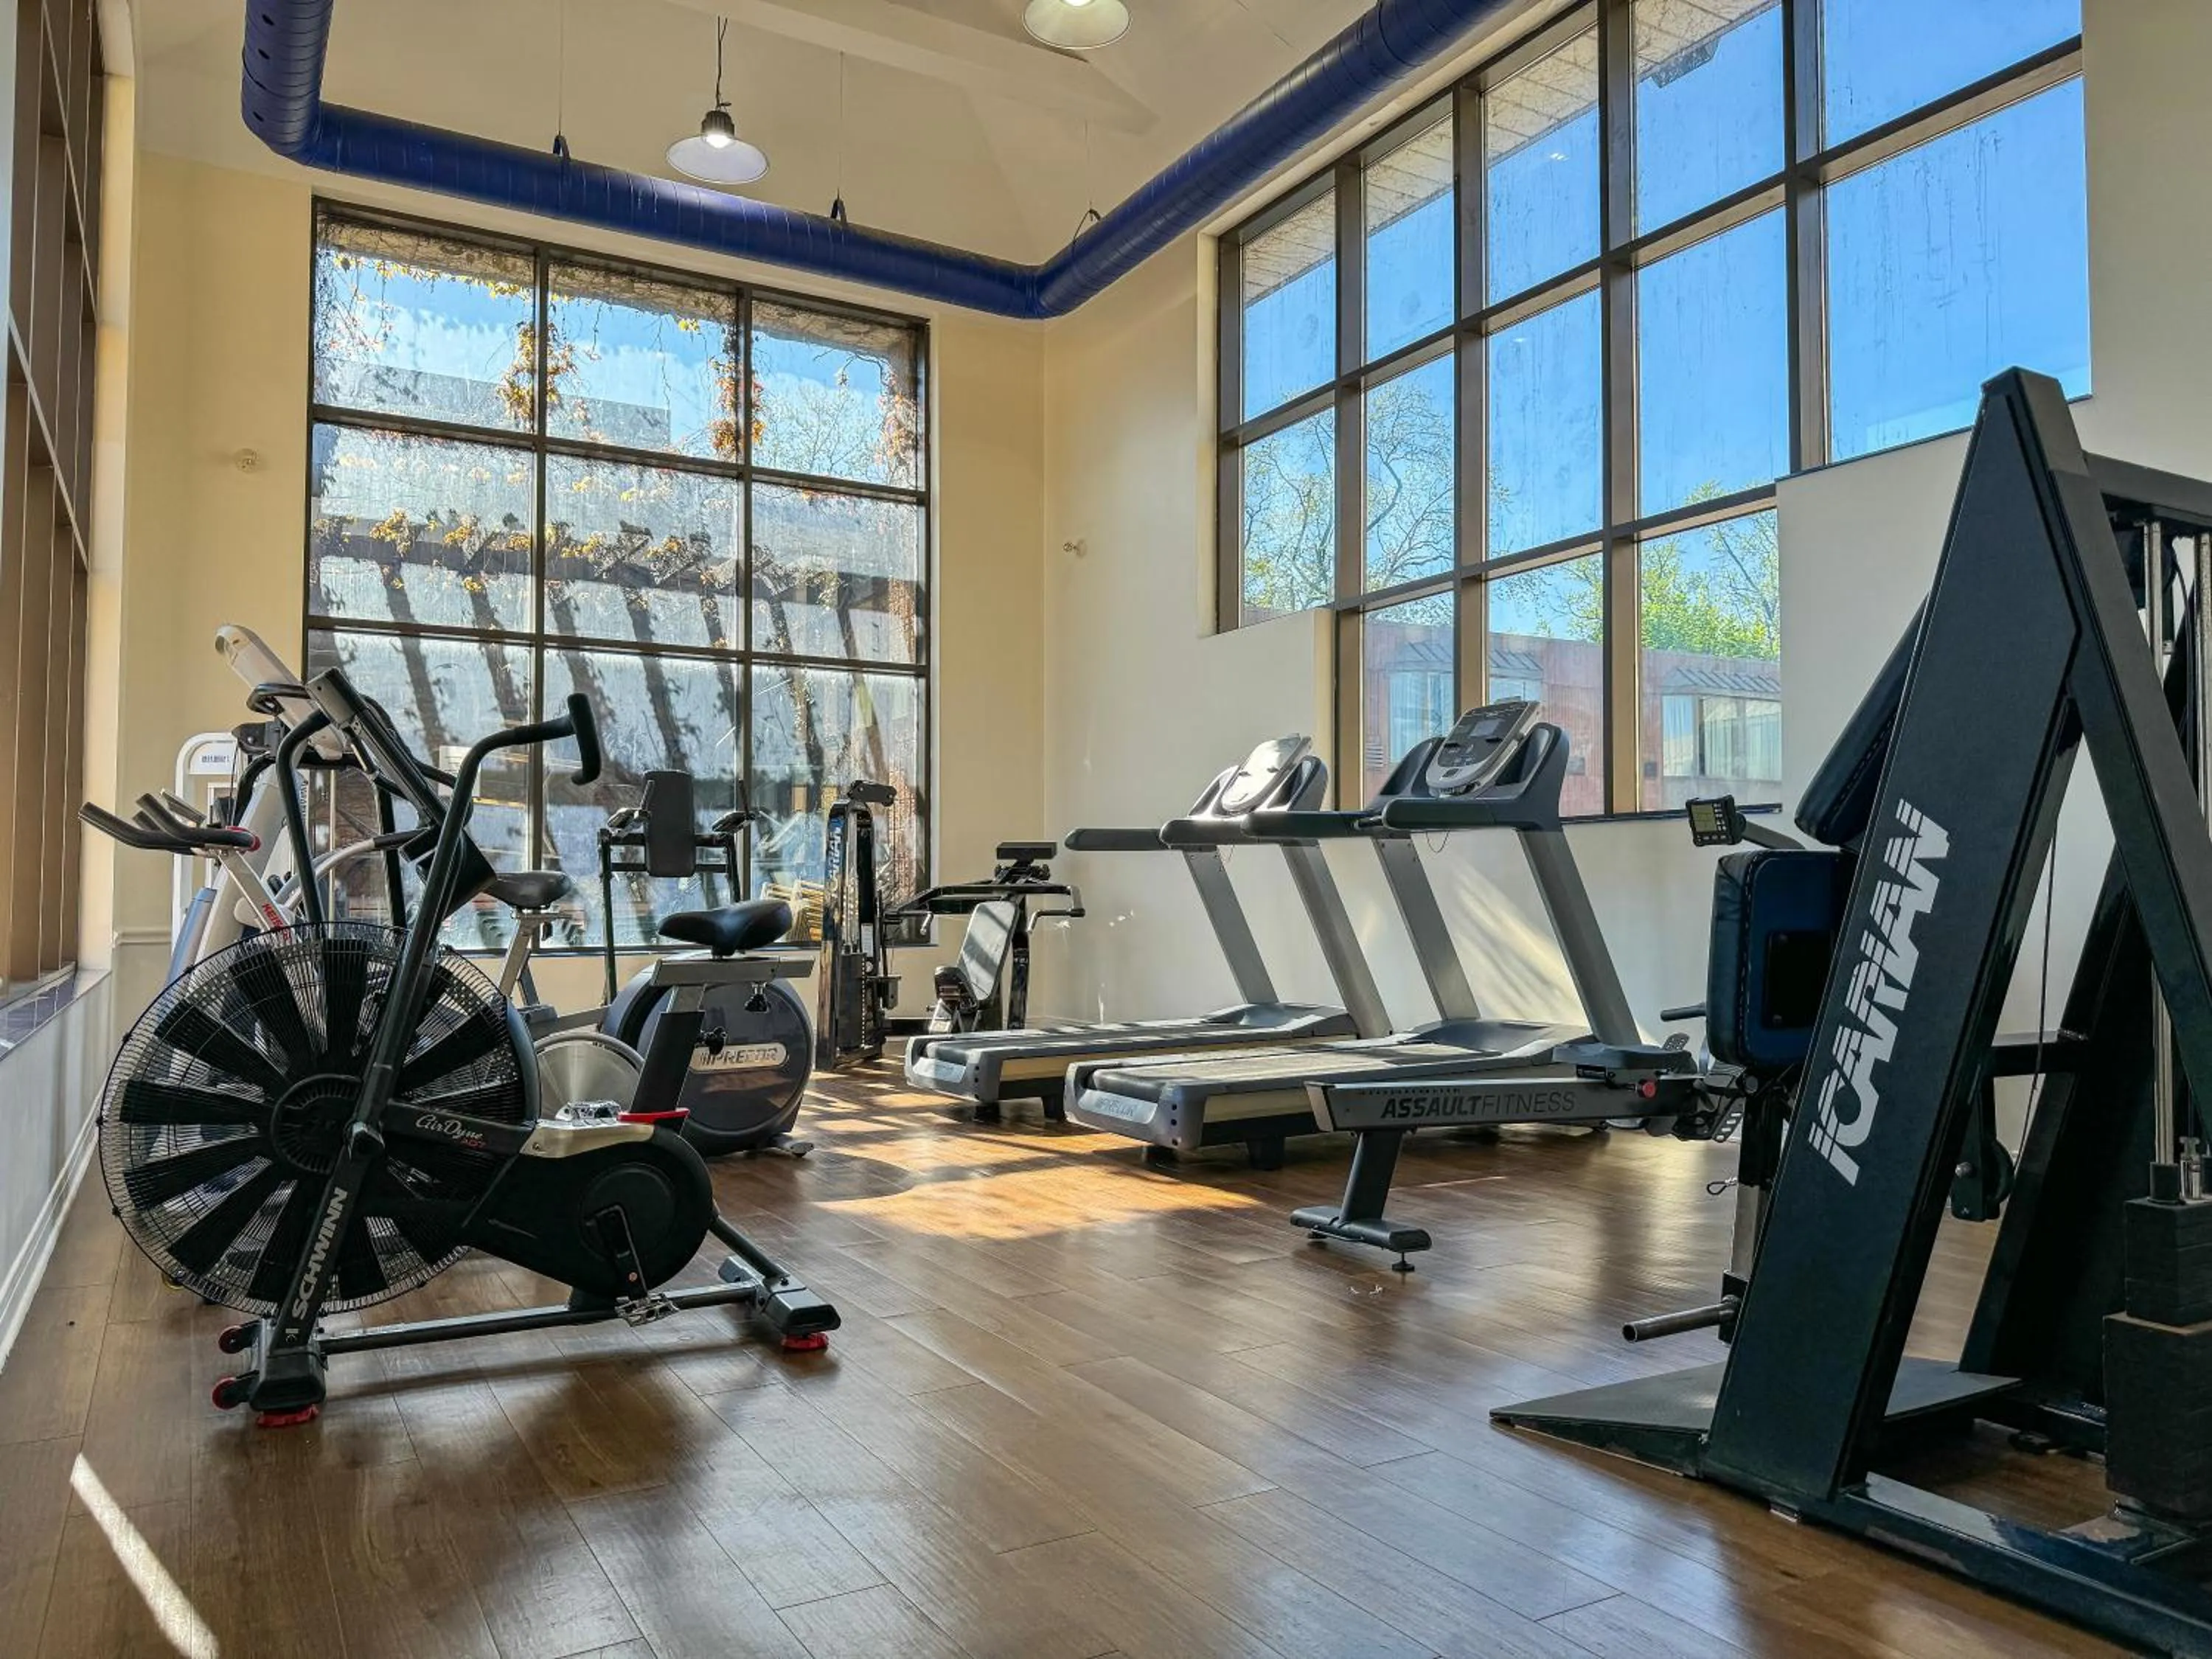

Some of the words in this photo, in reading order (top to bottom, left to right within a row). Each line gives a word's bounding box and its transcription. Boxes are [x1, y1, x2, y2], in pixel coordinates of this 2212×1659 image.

[1808, 799, 1950, 1186] ICARIAN
[1380, 1091, 1577, 1119] ASSAULTFITNESS
[292, 1186, 348, 1321] SCHWINN
